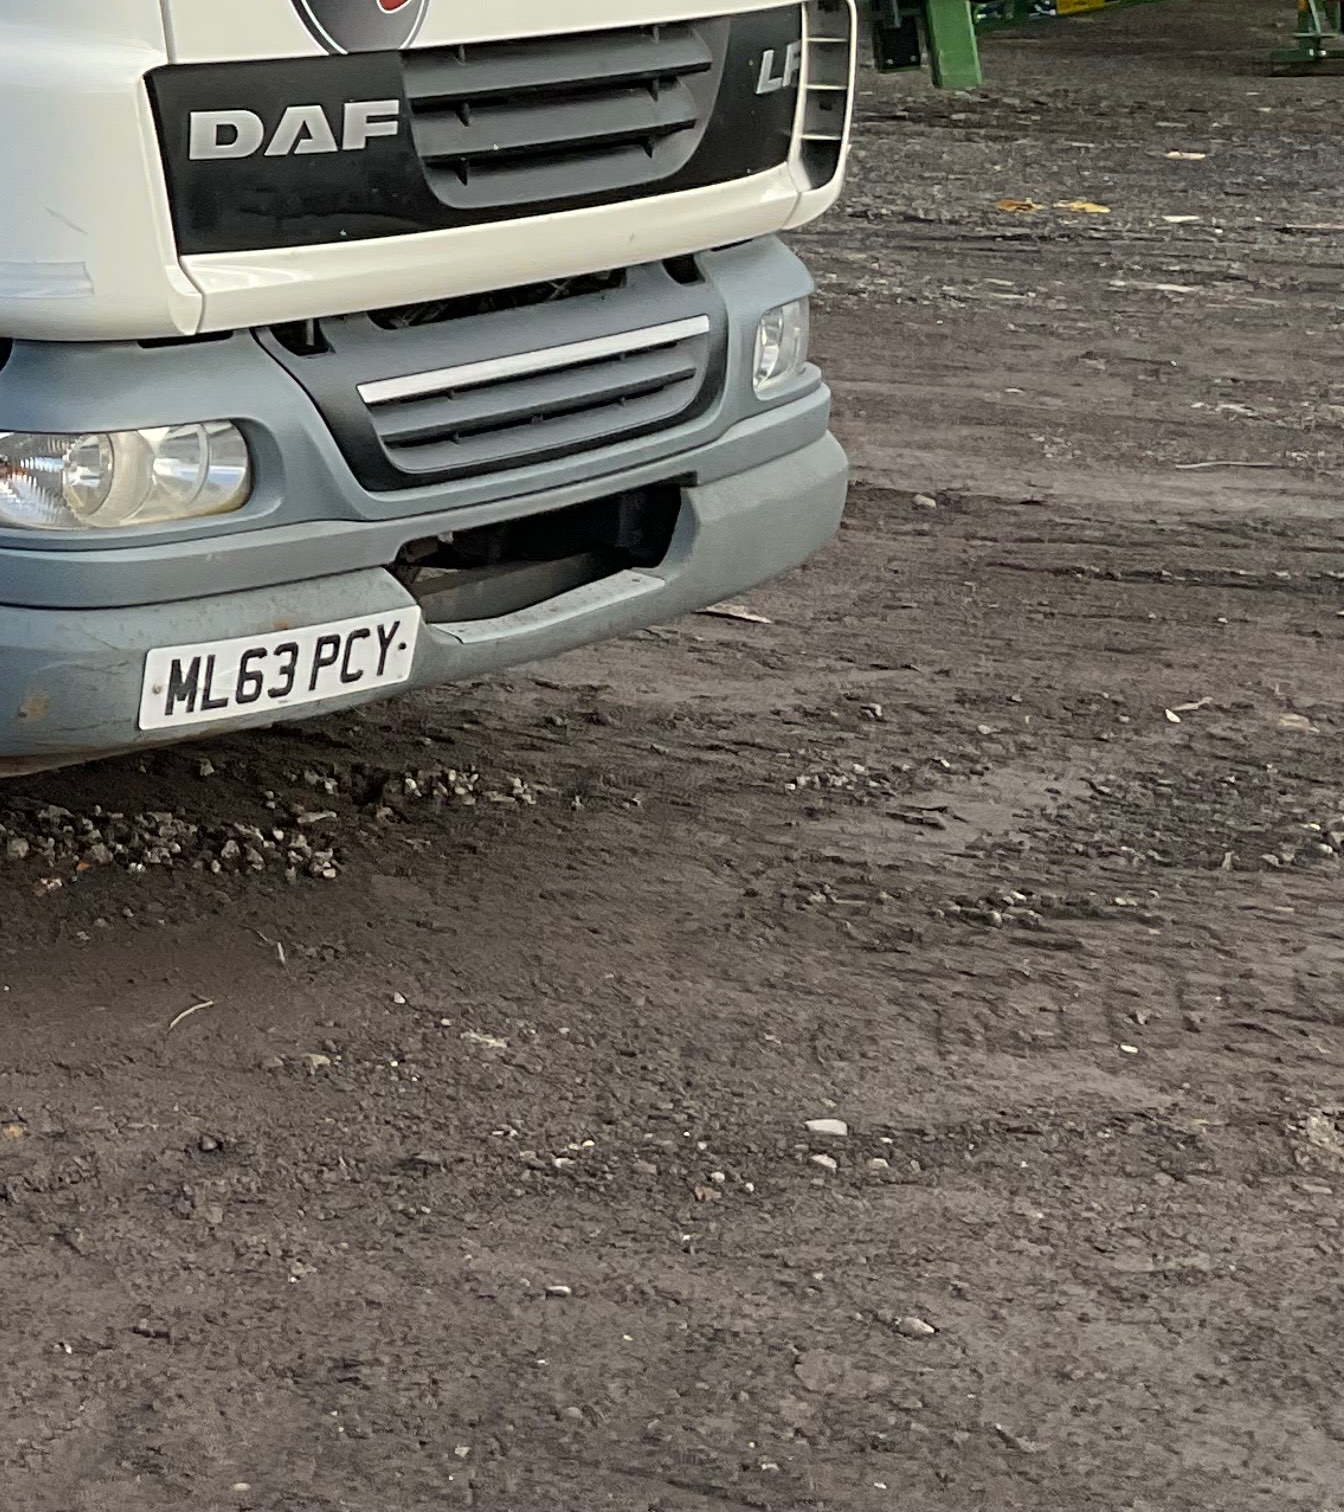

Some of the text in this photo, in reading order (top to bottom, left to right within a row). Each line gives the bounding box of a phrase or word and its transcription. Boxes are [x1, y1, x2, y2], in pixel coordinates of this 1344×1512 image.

[188, 100, 400, 161] DAF
[164, 620, 400, 717] ML63 PCY
